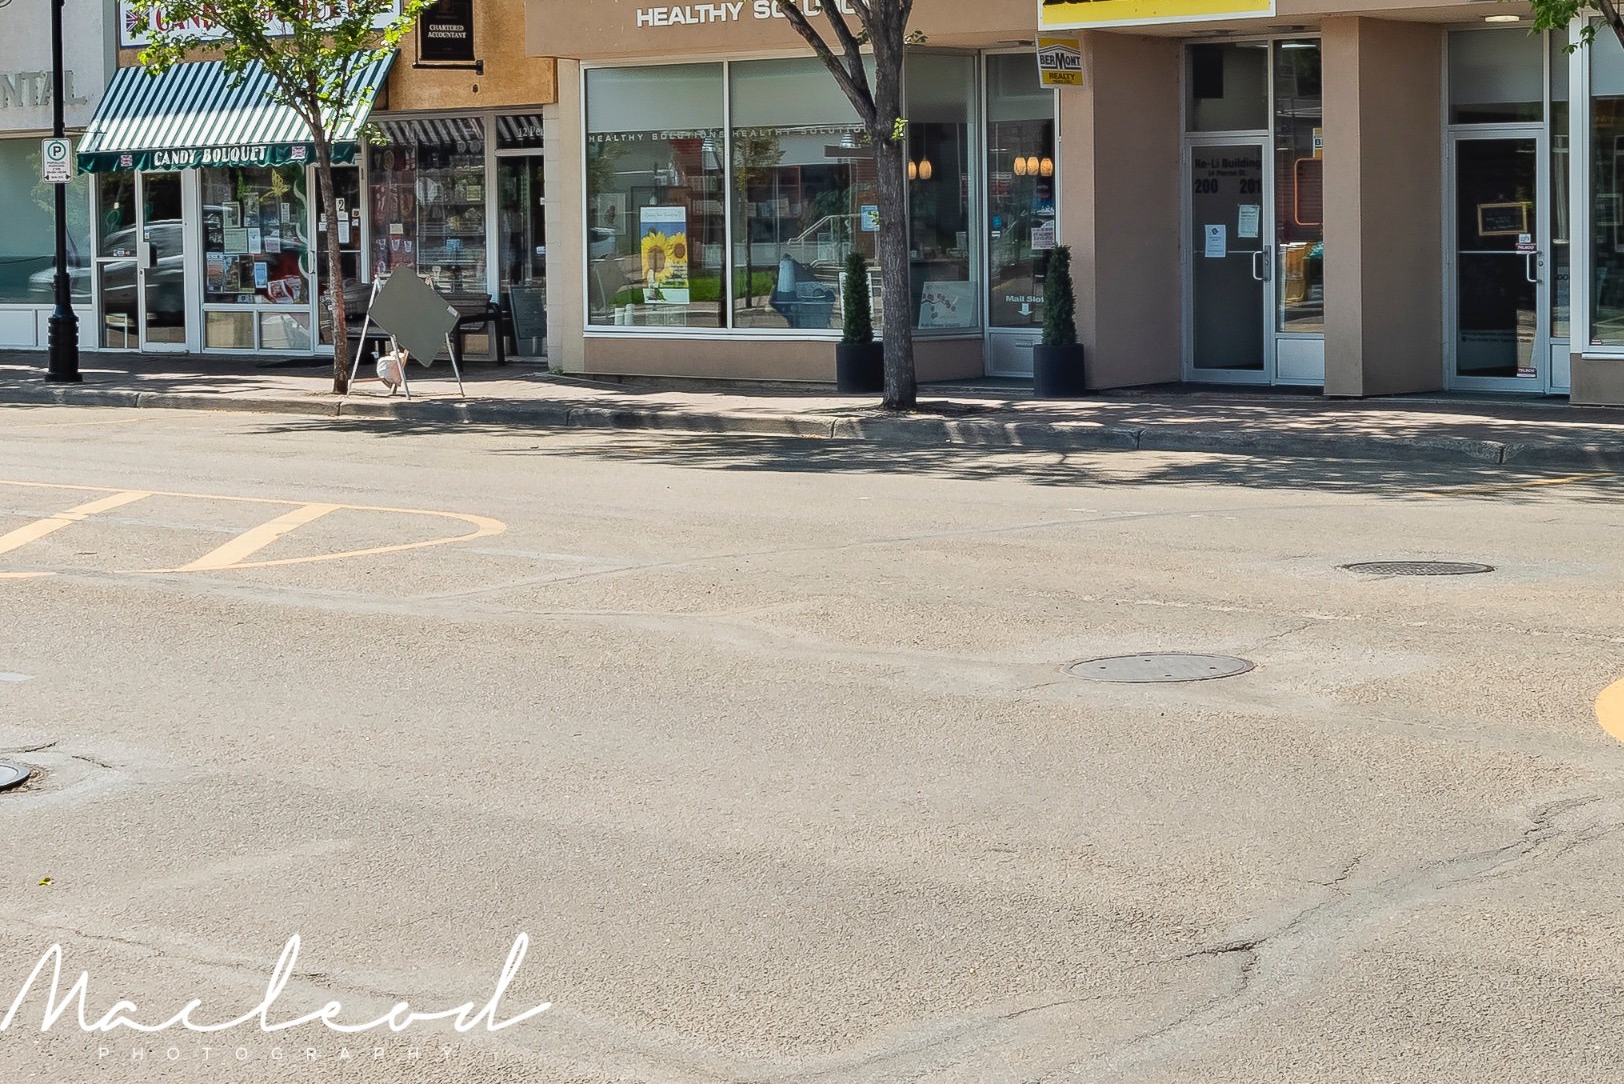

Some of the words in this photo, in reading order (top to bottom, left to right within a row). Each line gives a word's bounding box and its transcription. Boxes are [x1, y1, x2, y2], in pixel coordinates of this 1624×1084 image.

[636, 1, 744, 27] HEALTHY
[1048, 72, 1076, 80] REALTY
[588, 132, 644, 143] HEALTHY
[652, 129, 725, 141] SOLUTIONS
[732, 127, 791, 137] HEALTHY
[53, 145, 61, 156] P
[154, 149, 197, 166] CANDY
[202, 146, 267, 163] BOUQUET
[1222, 158, 1261, 170] Building
[1195, 178, 1218, 193] 200
[1240, 178, 1262, 193] 201
[338, 199, 344, 212] 2
[1005, 295, 1025, 303] Mail
